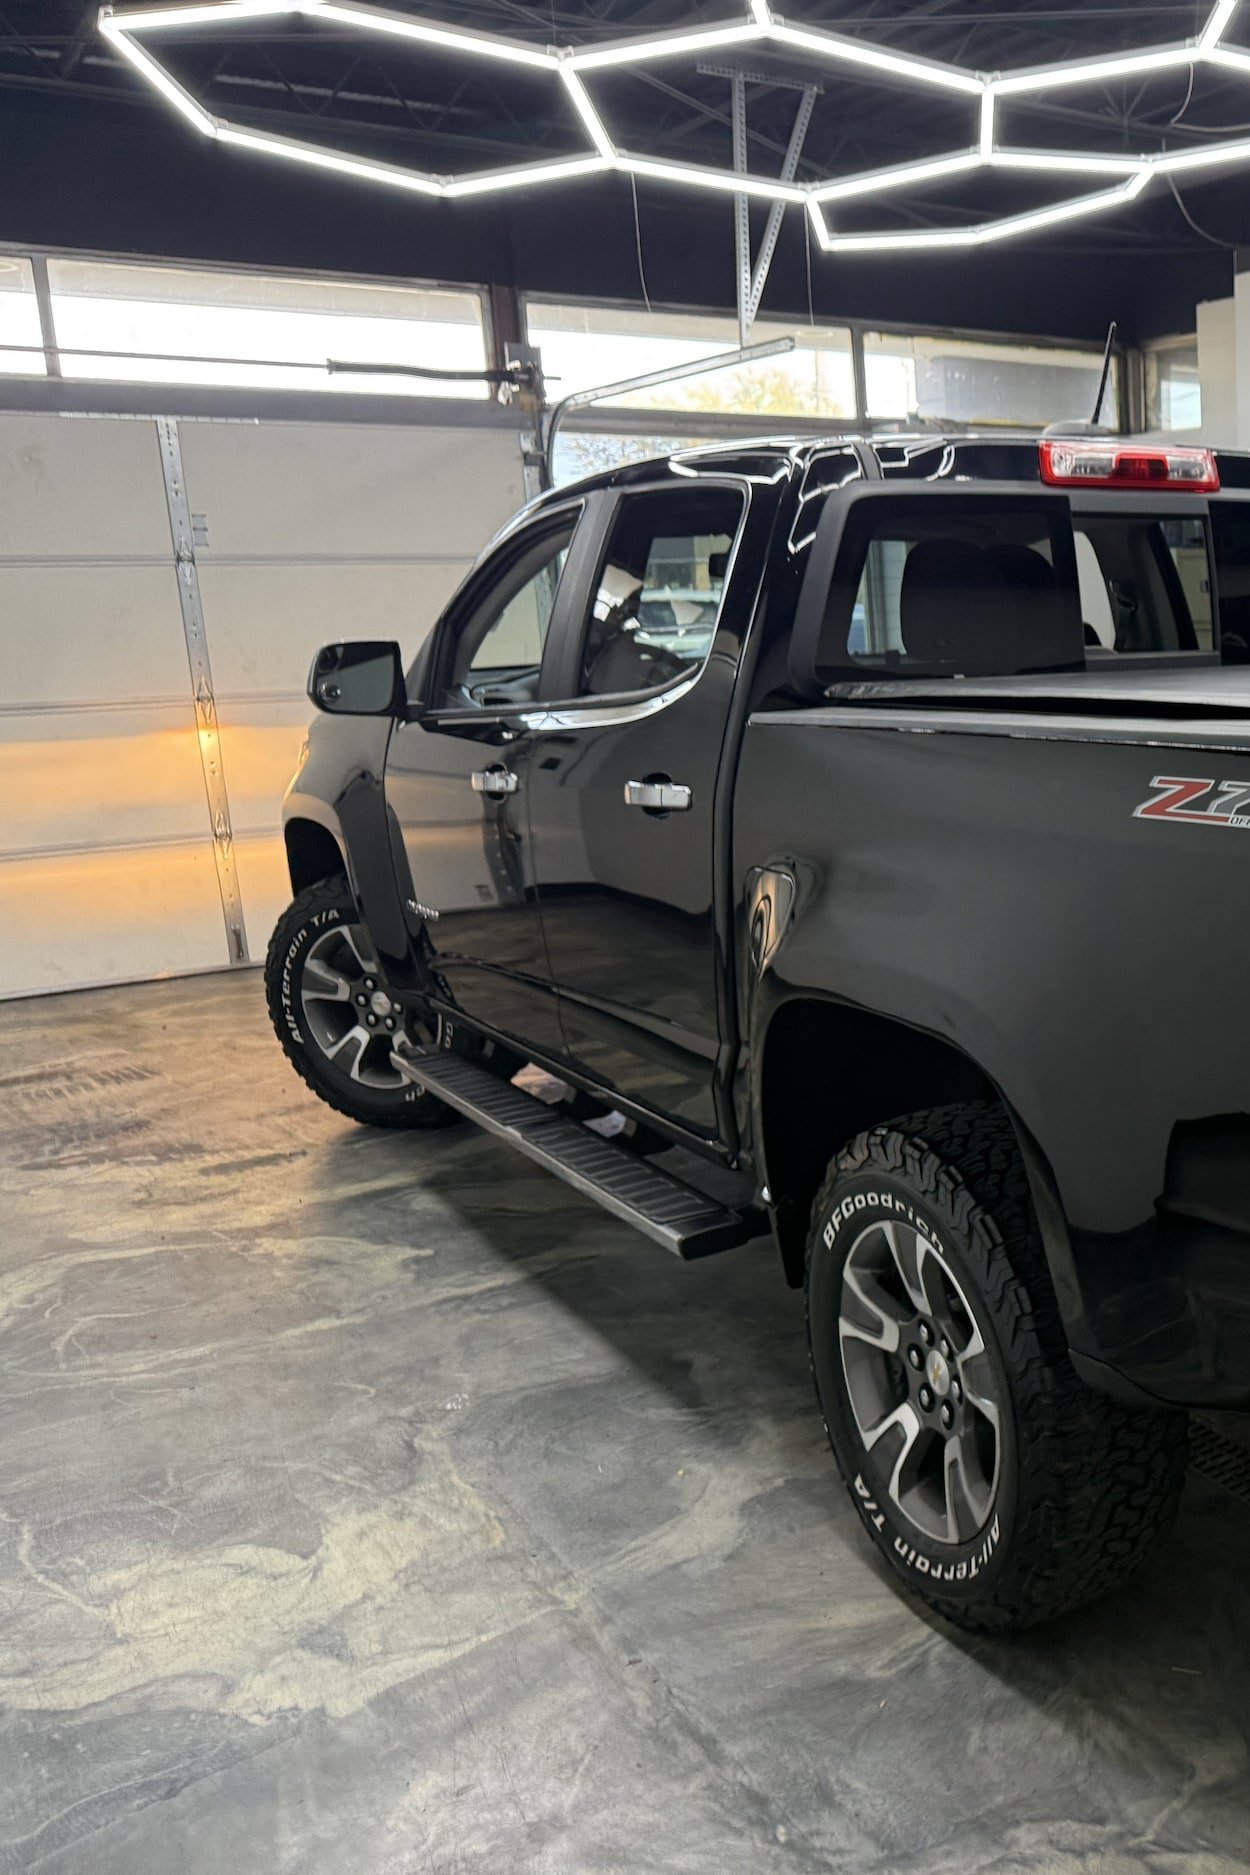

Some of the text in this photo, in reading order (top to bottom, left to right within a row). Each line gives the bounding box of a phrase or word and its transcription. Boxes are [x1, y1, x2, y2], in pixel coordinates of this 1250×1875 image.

[310, 908, 341, 928] T/A
[822, 1191, 946, 1255] BFGoodrich
[852, 1473, 1002, 1582] All-Terrain T/A
